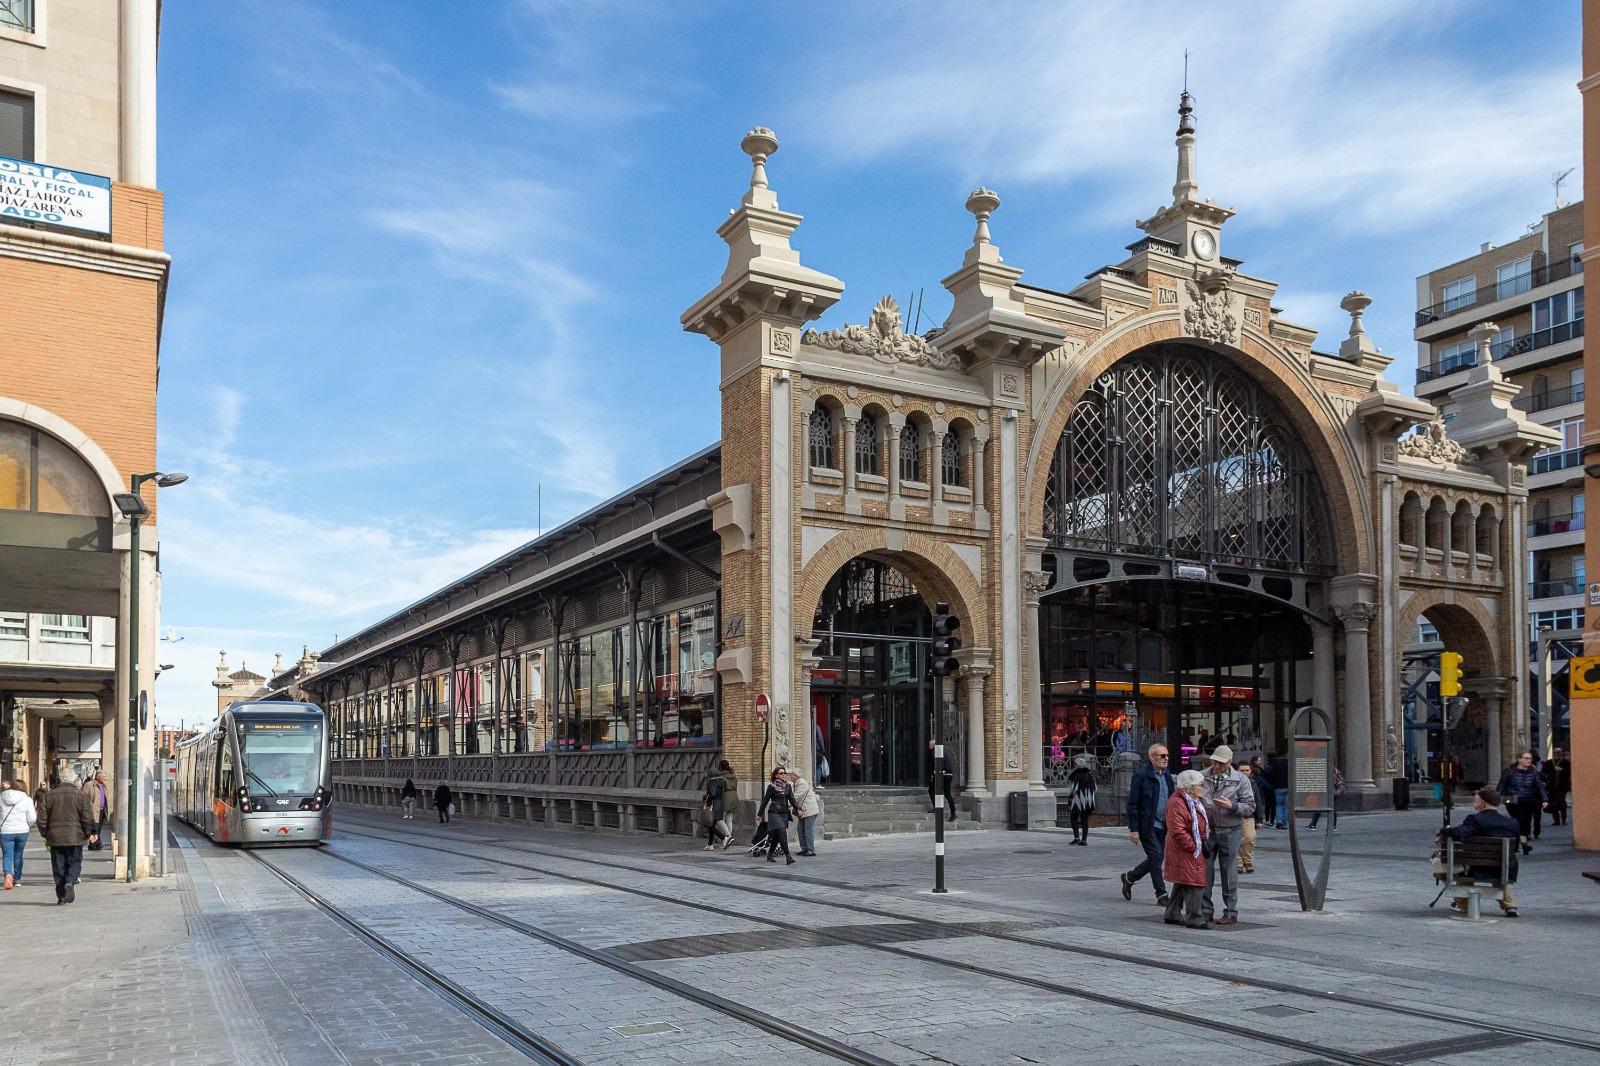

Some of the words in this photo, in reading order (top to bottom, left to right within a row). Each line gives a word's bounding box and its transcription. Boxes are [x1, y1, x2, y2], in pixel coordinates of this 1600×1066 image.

[26, 189, 72, 206] LAHOZ
[32, 180, 39, 188] Y
[46, 182, 94, 199] FISCAL
[2, 206, 62, 222] ADO
[31, 201, 83, 218] ARENAS
